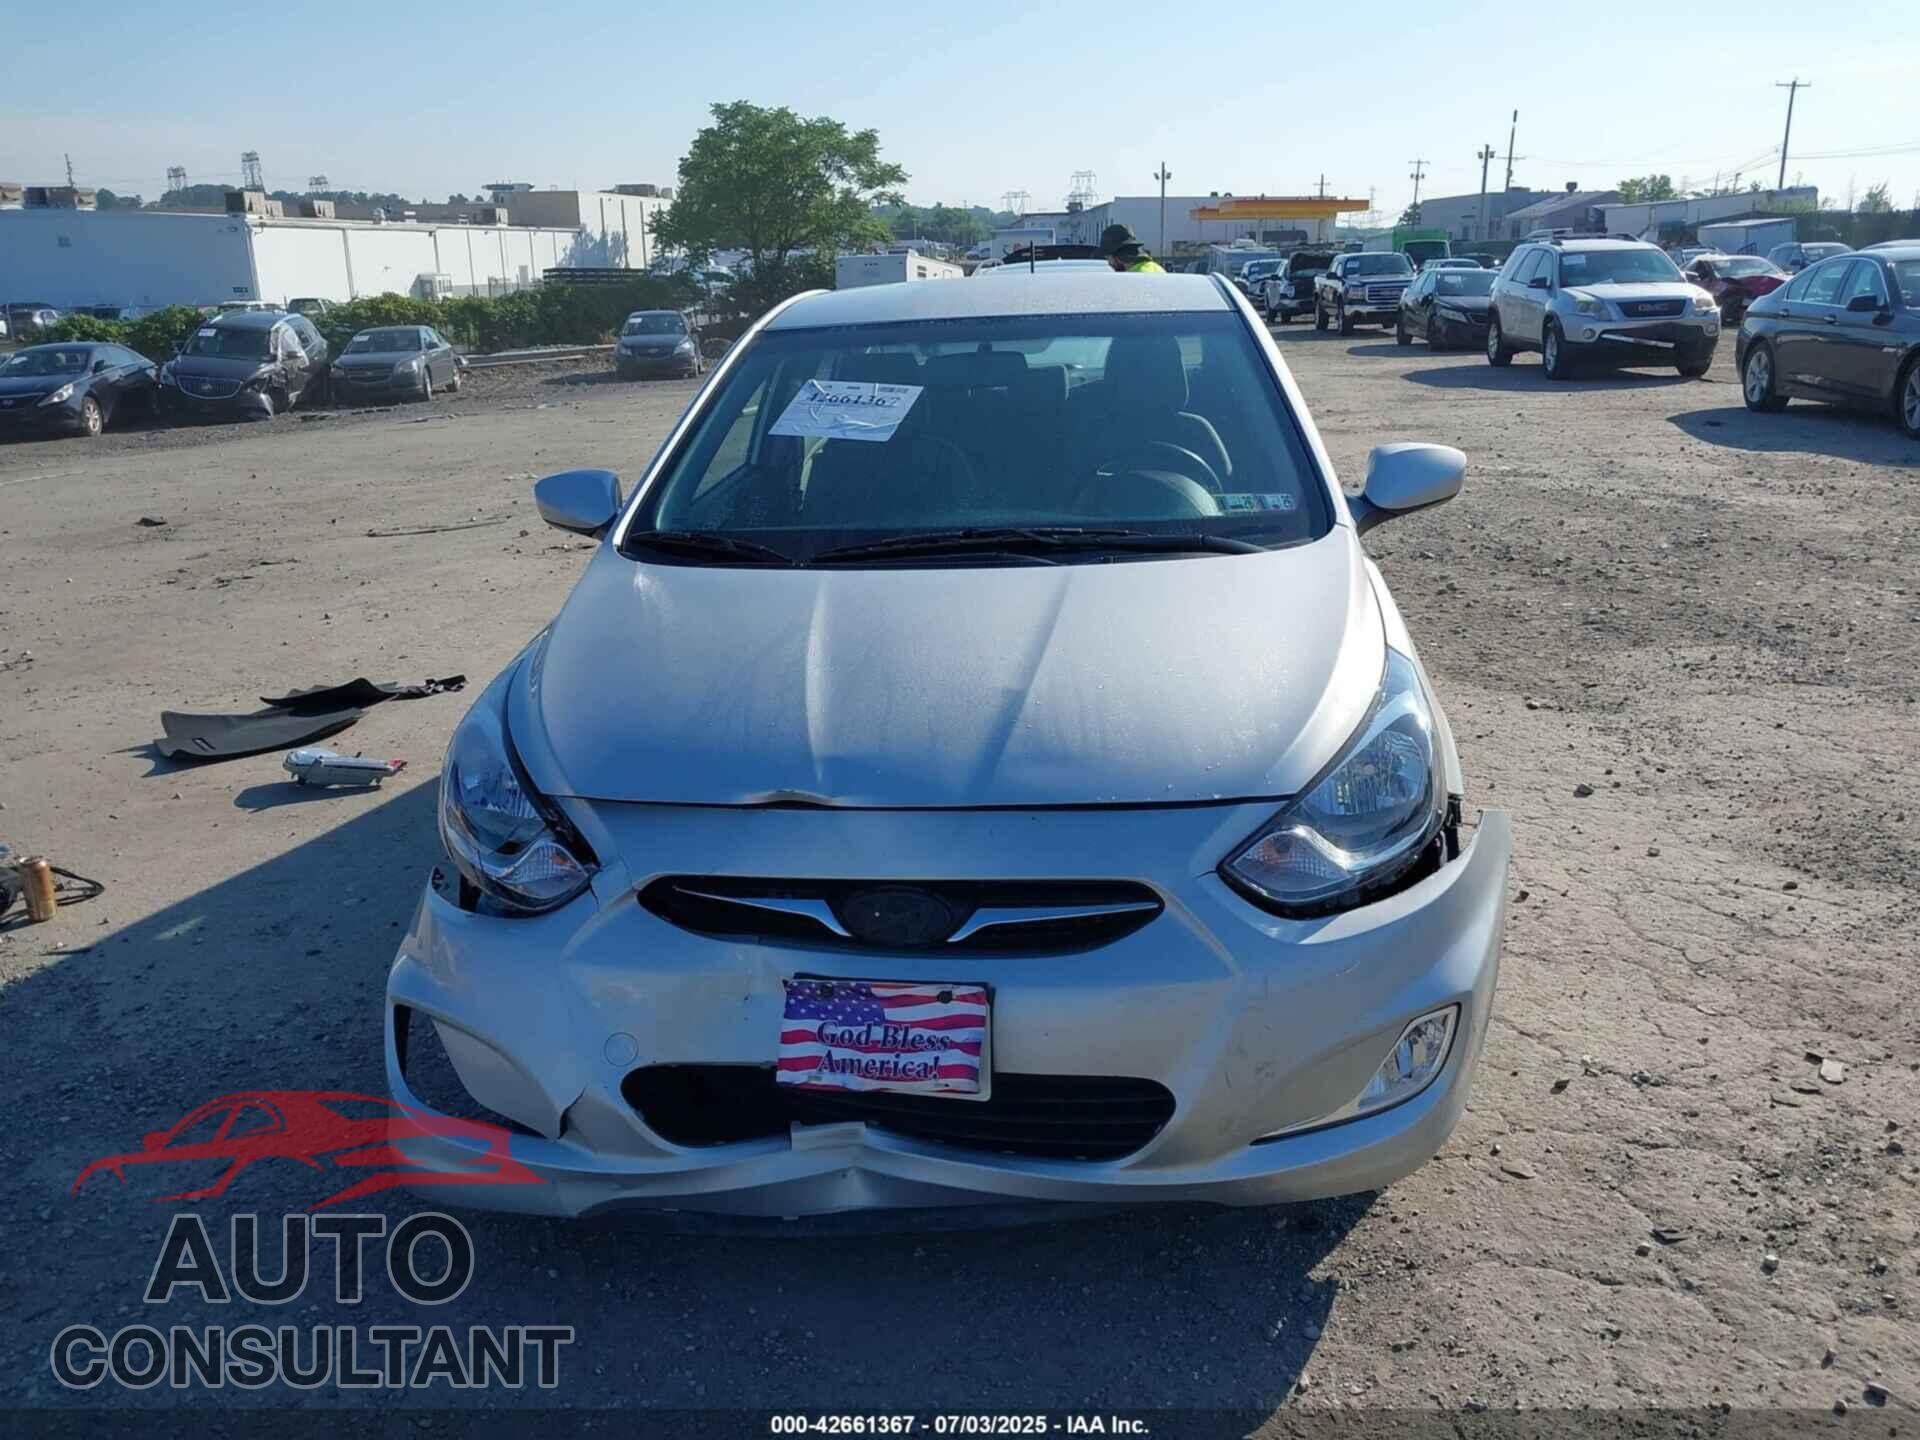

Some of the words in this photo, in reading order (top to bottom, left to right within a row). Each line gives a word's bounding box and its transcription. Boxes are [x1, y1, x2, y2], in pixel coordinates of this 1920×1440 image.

[817, 1021, 873, 1048] God
[880, 1024, 951, 1051] Bless
[818, 1049, 940, 1080] America!
